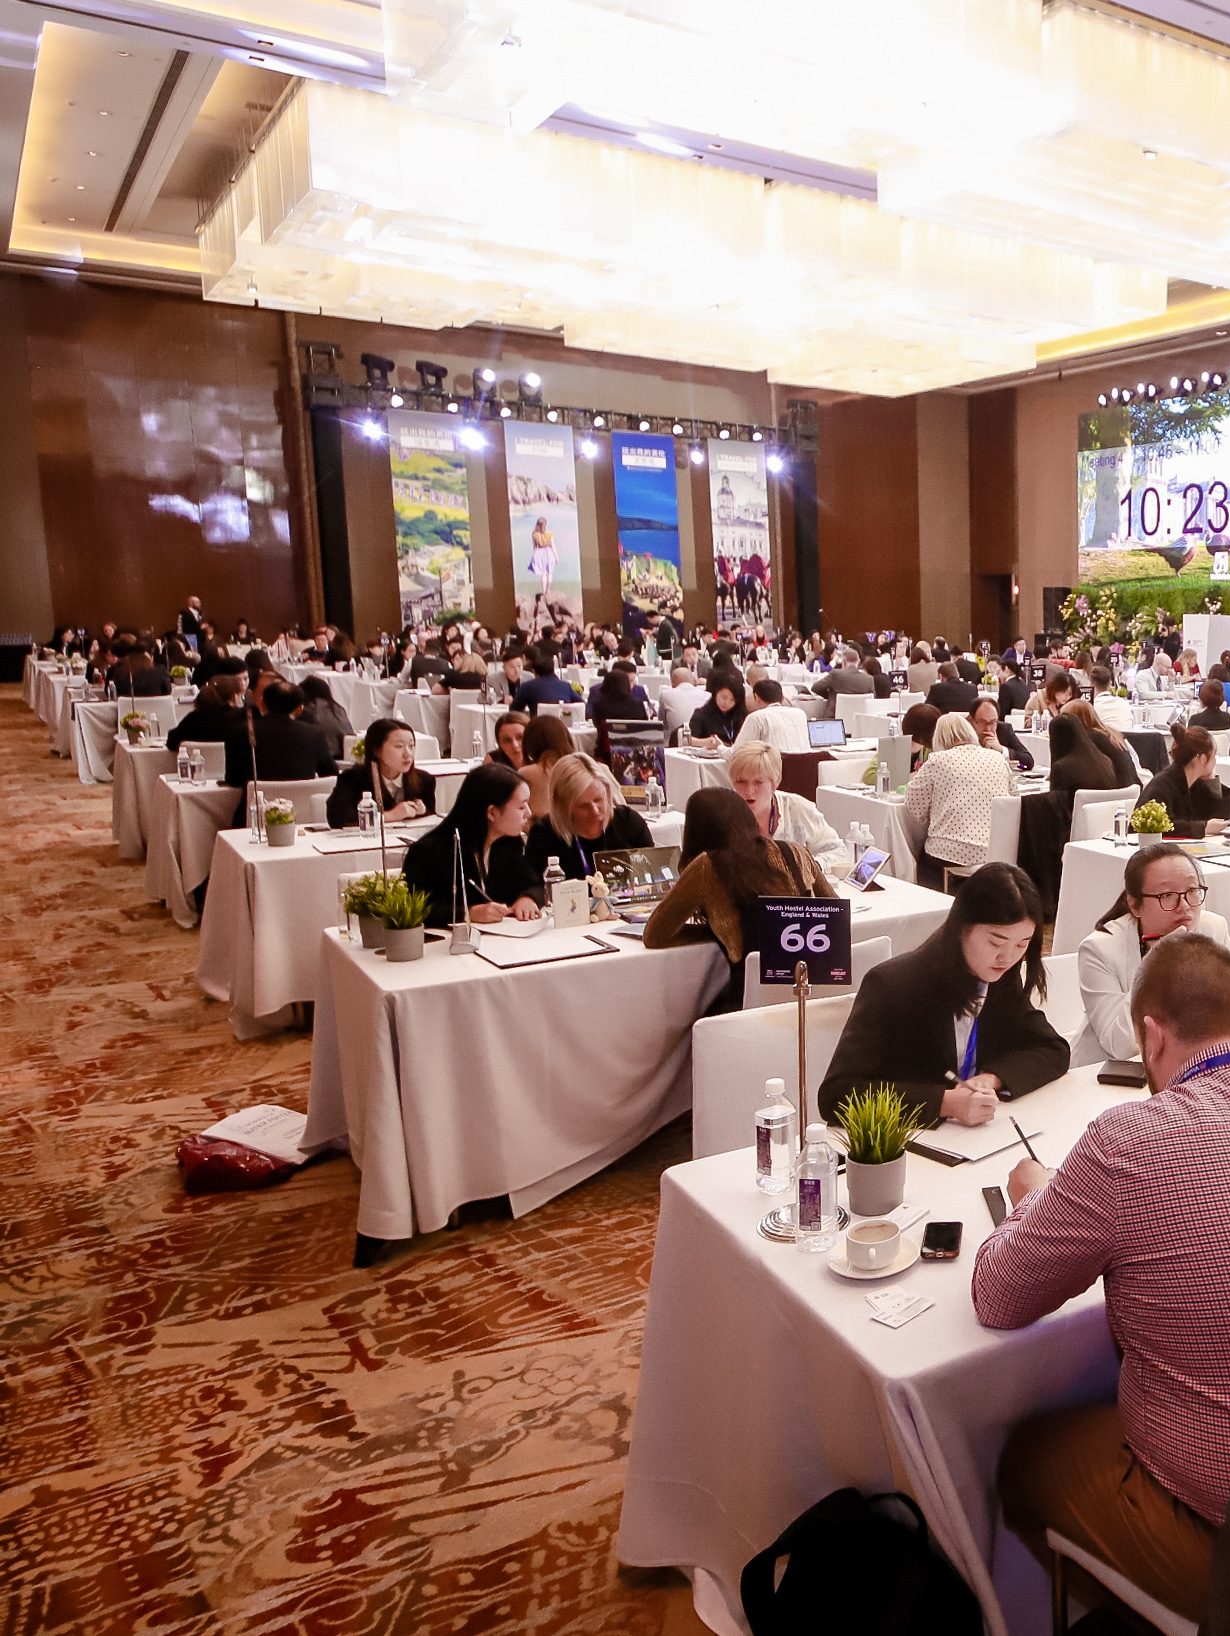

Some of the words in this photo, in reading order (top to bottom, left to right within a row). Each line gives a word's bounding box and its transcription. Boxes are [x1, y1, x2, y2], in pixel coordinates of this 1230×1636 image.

[1120, 481, 1229, 537] 10:23
[892, 675, 904, 684] 46
[1080, 693, 1092, 702] 45
[780, 923, 831, 953] 66
